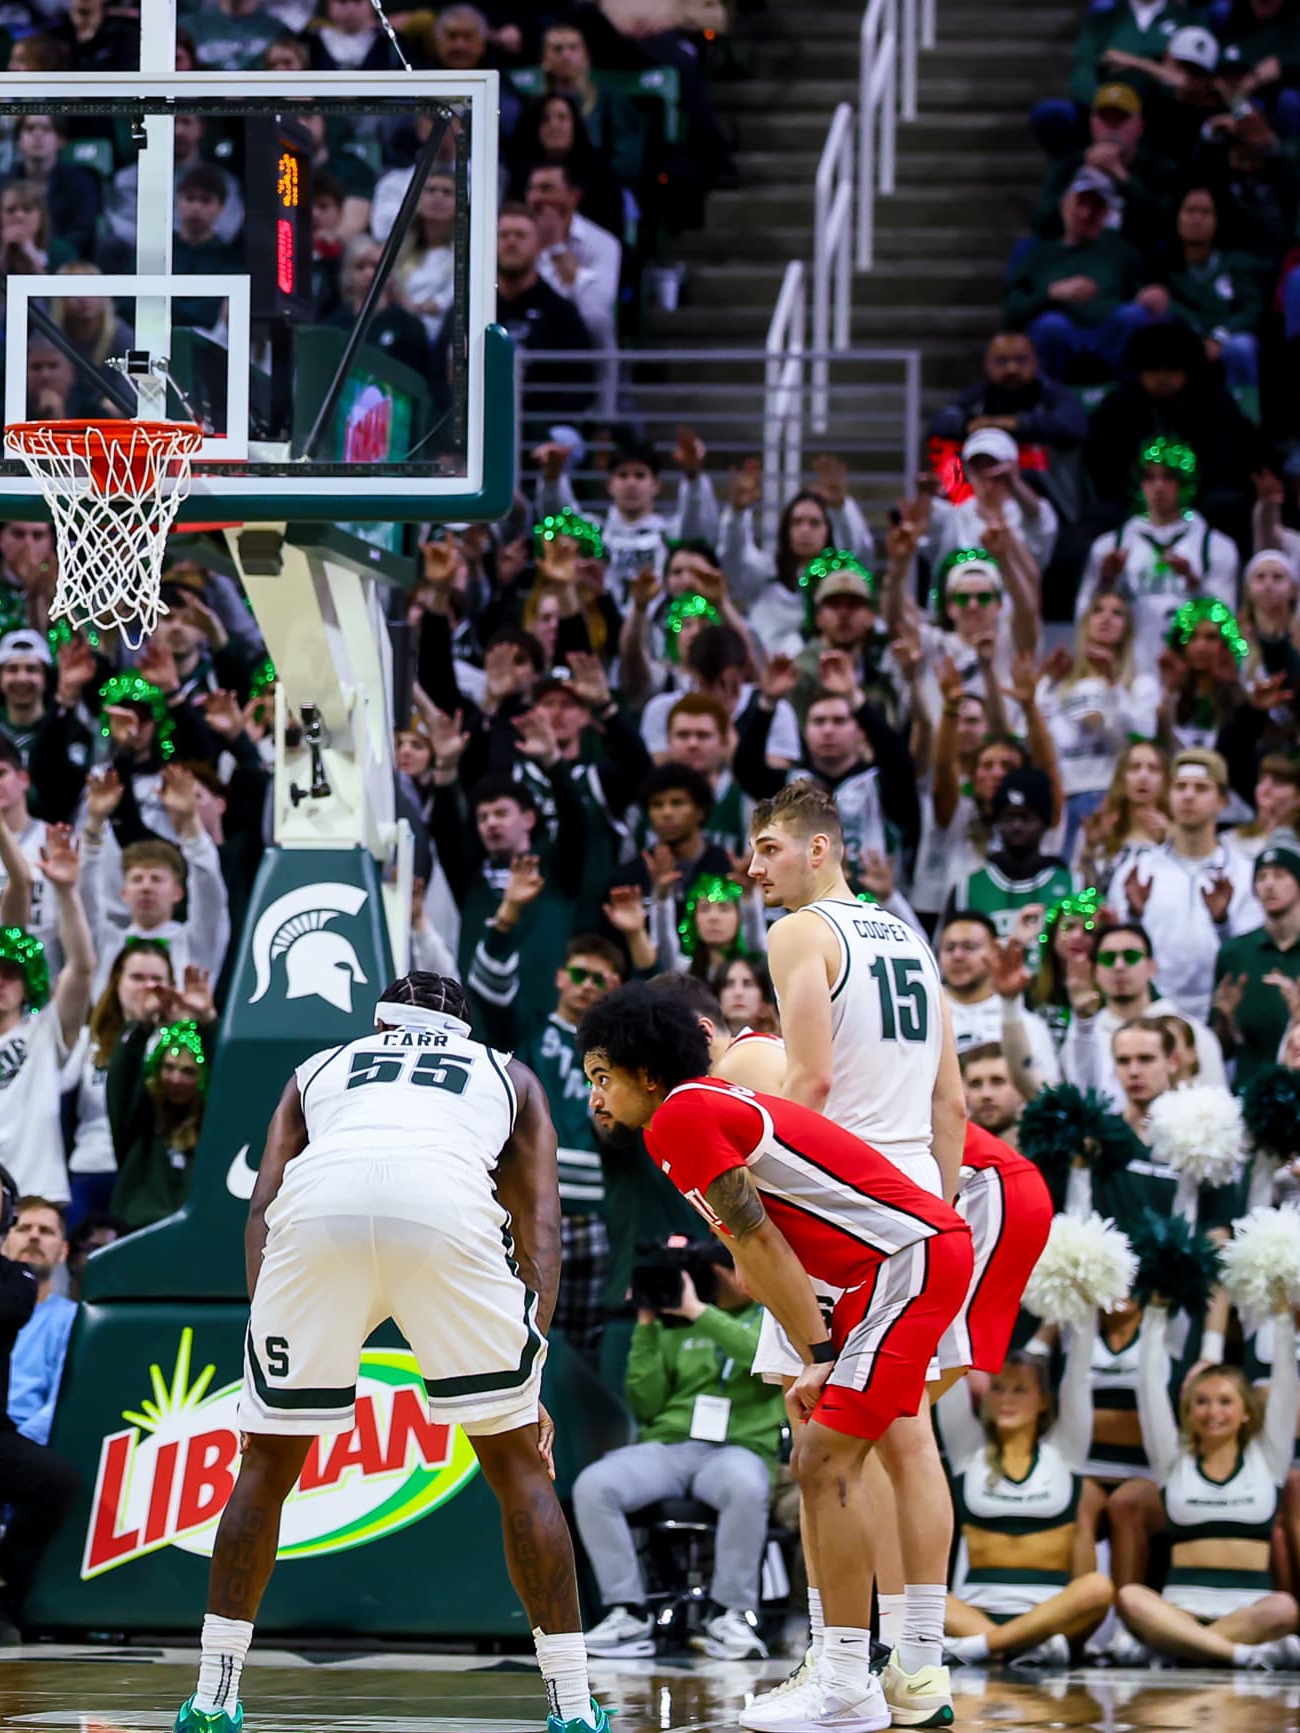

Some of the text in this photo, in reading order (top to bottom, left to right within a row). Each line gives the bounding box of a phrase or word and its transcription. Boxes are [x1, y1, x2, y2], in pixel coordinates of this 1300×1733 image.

[853, 918, 910, 943] COOPER
[869, 954, 928, 1043] 15
[383, 1033, 448, 1048] CARR
[346, 1051, 474, 1097] 55
[265, 1336, 290, 1377] S
[85, 1388, 452, 1570] LIBAN
